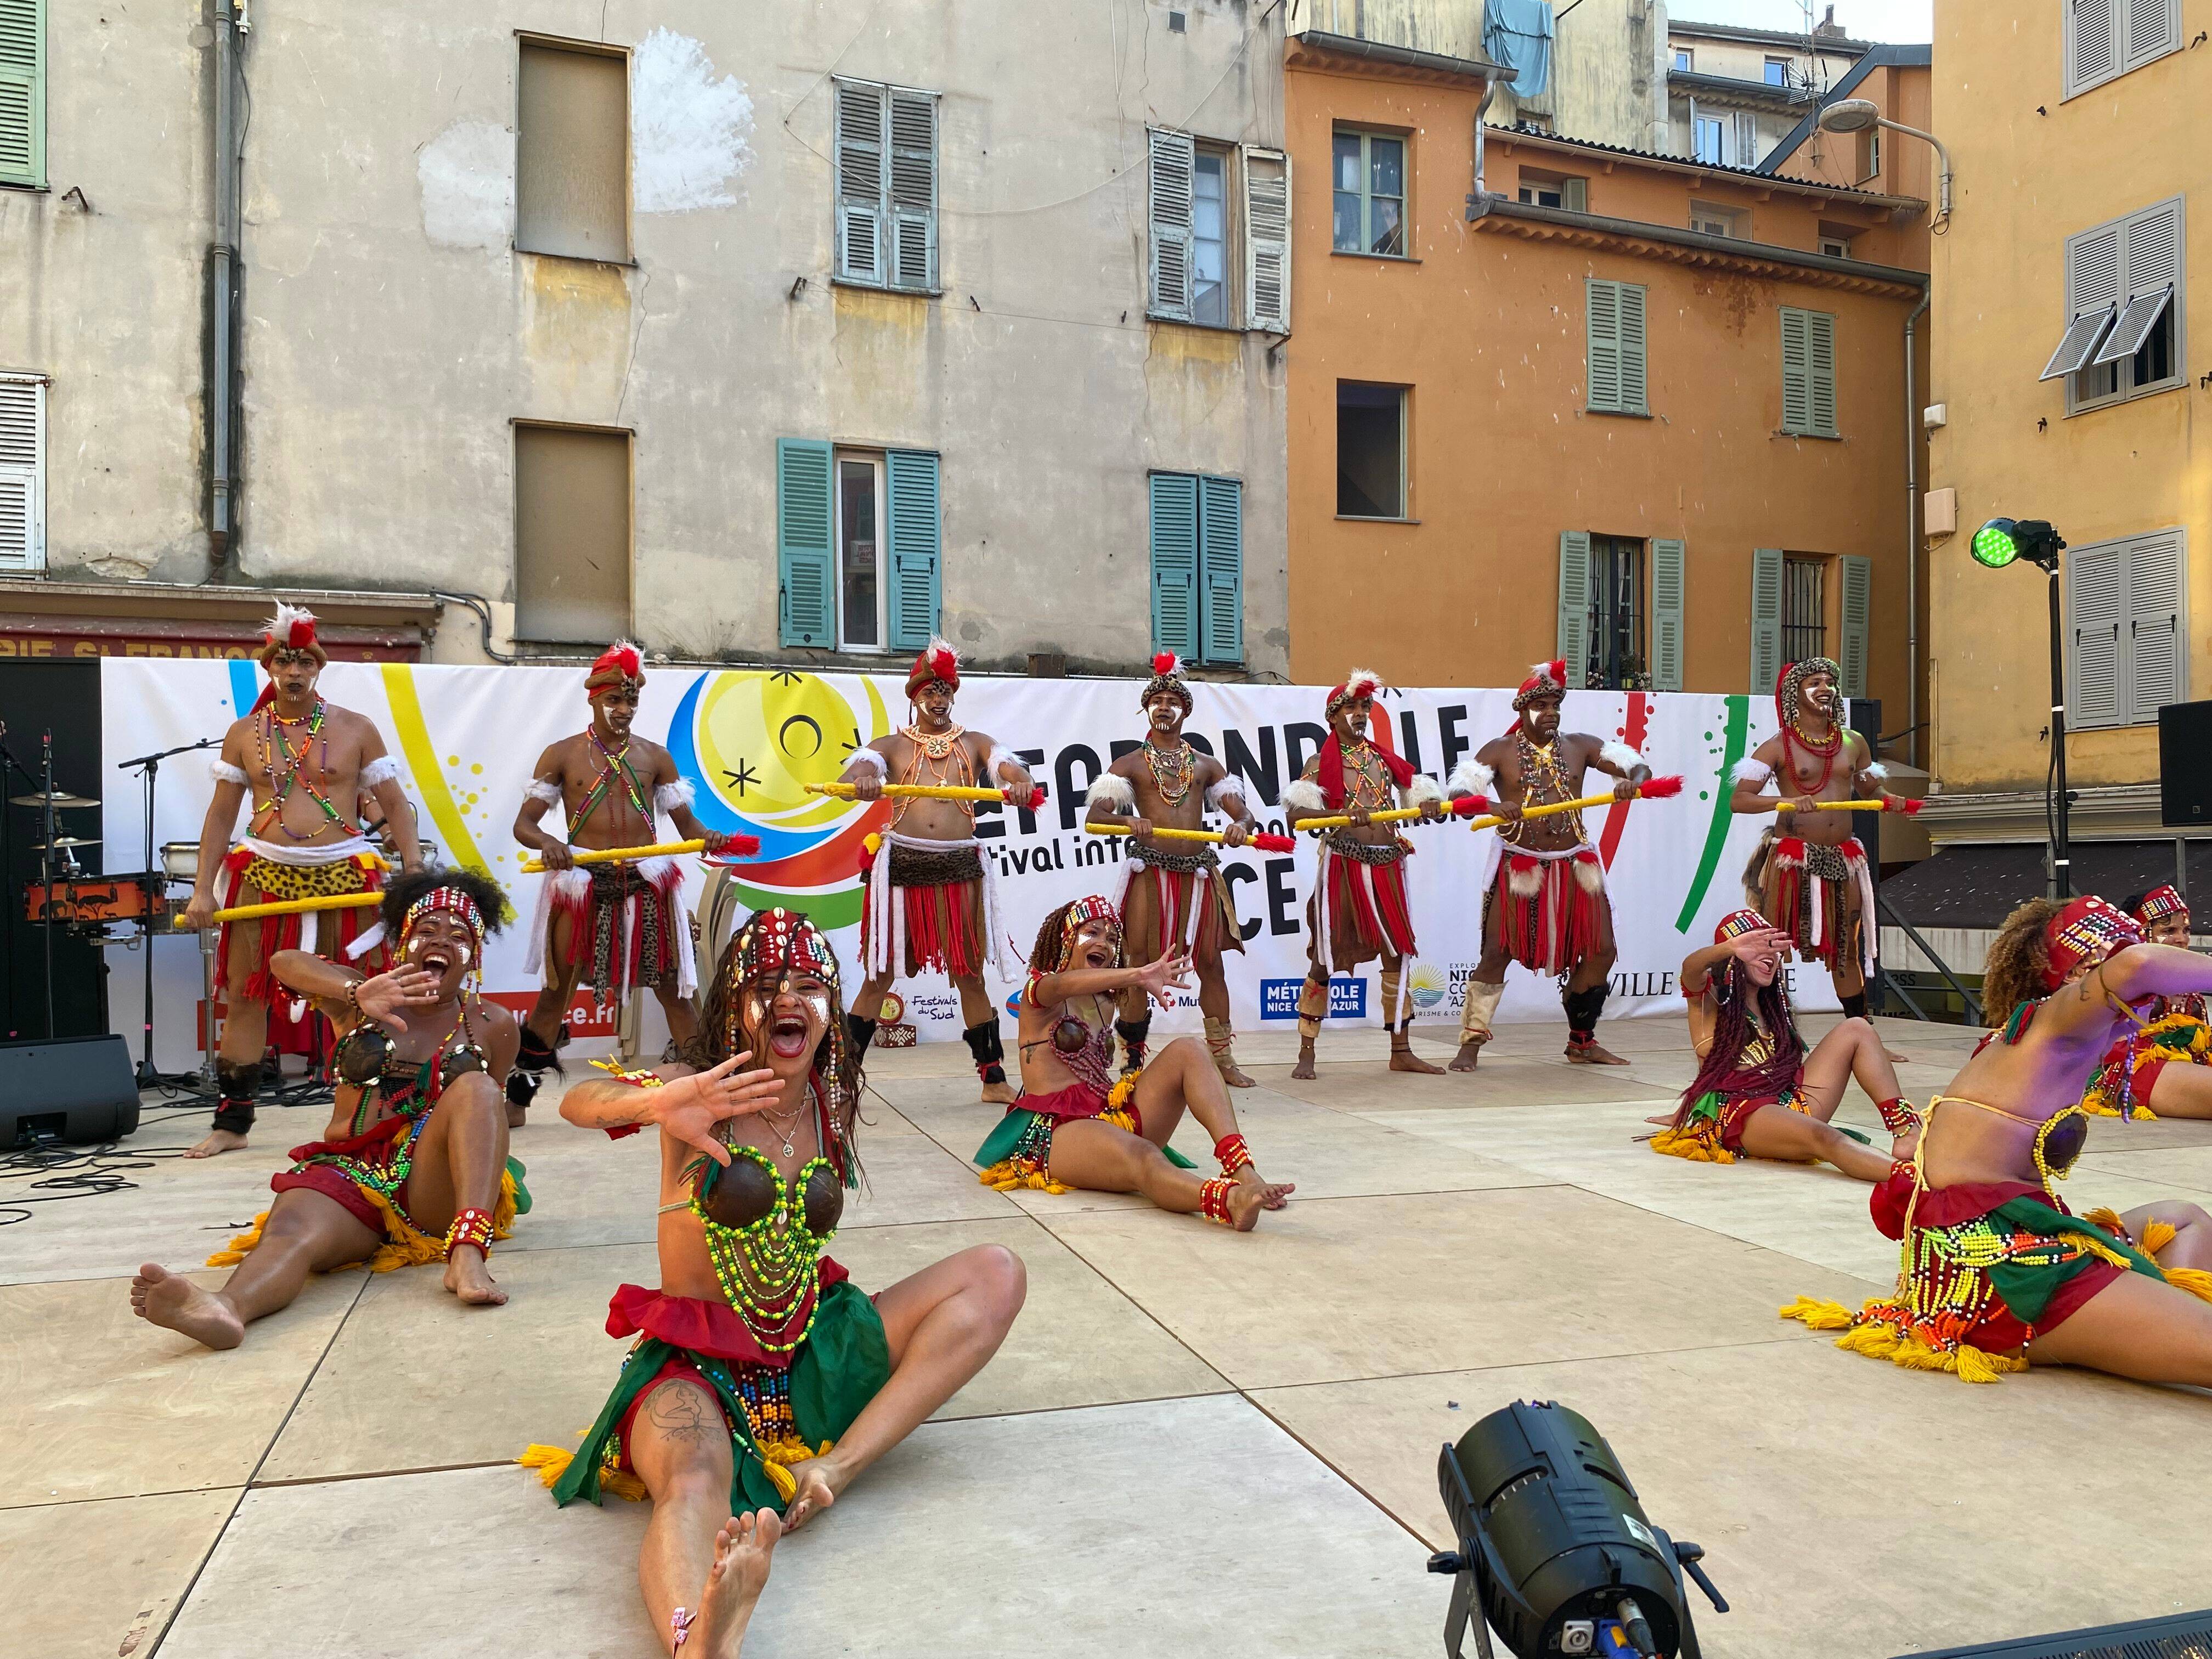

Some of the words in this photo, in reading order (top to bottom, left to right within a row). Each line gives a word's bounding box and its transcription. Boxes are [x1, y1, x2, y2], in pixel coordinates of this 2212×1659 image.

[911, 995, 958, 1006] Festivals
[1267, 1002, 1292, 1012] NICE
[918, 1007, 929, 1015] du
[930, 1007, 955, 1020] Sud
